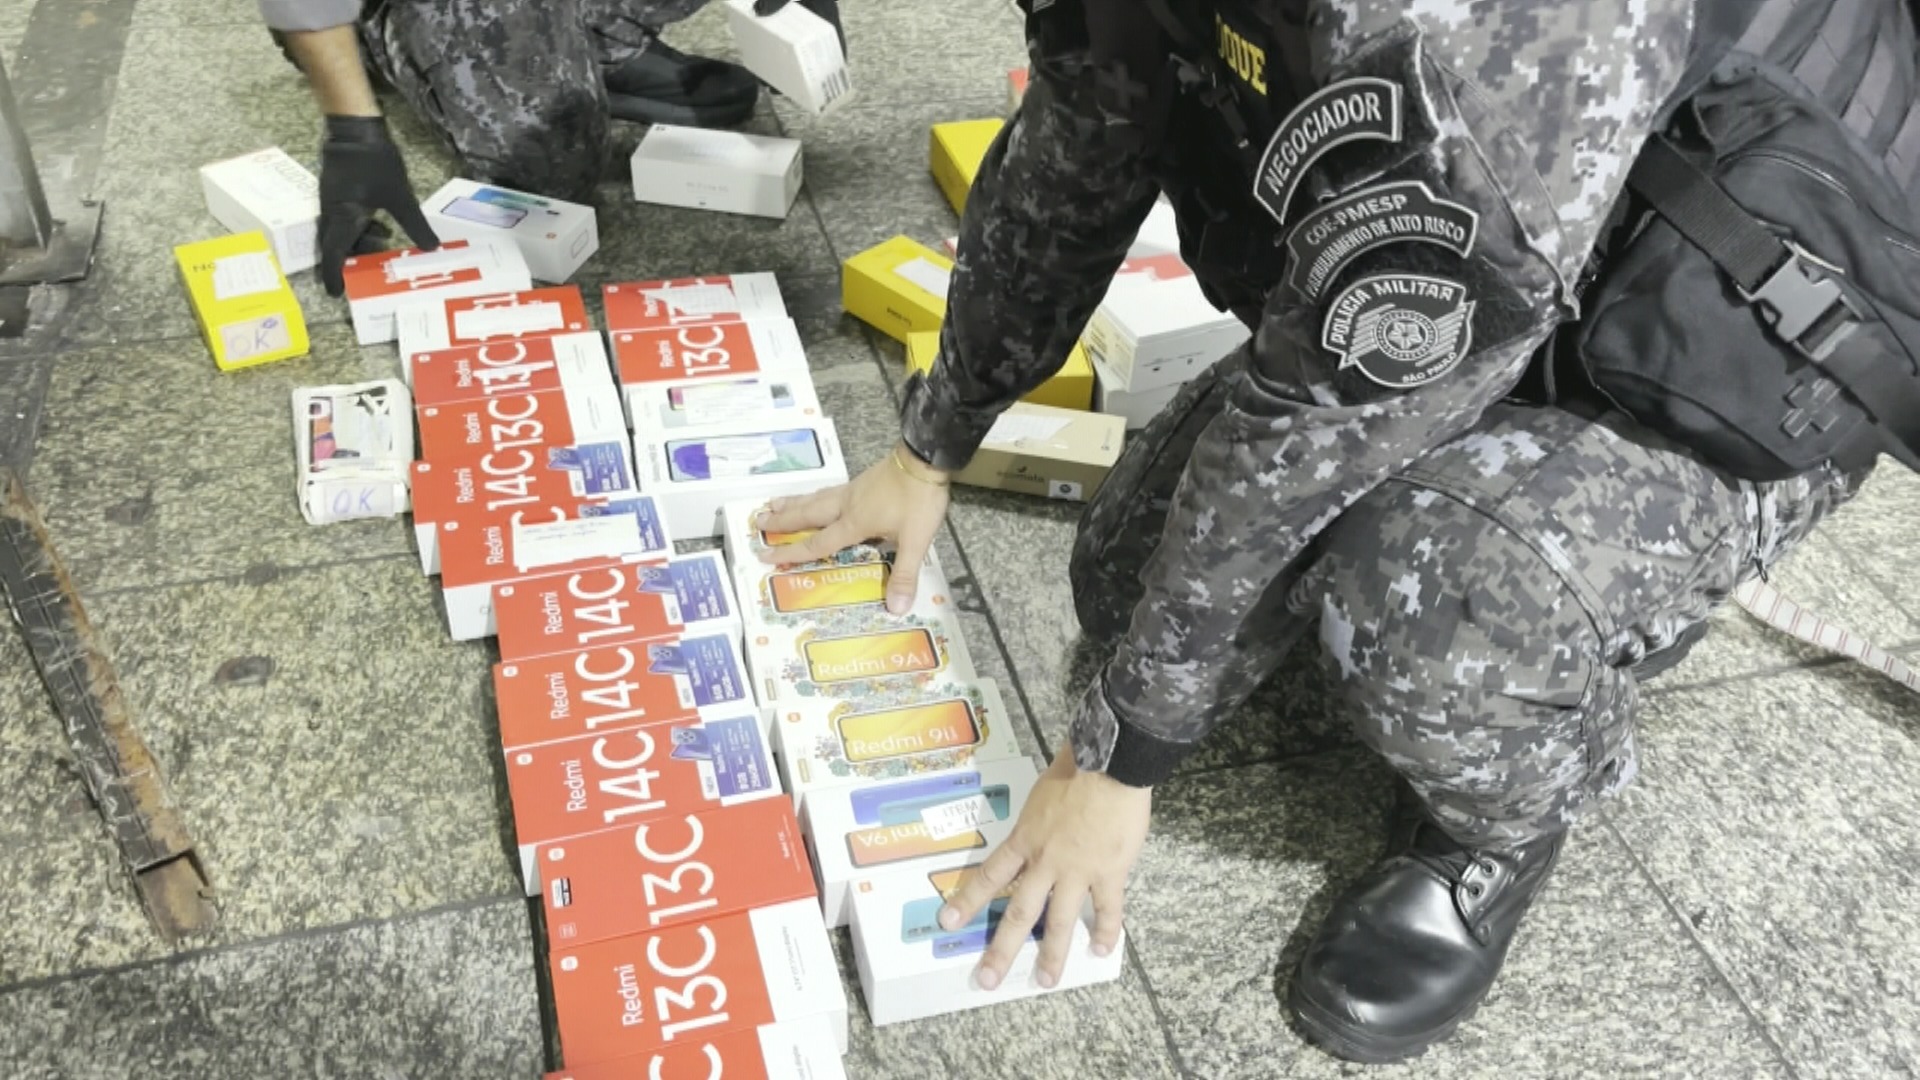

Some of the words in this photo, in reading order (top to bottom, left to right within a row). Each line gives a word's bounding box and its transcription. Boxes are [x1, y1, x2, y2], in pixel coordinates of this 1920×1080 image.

[1264, 90, 1382, 195] NEGOCIADOR
[1305, 193, 1408, 246] COE-PMESP
[1368, 218, 1392, 238] DE
[1389, 214, 1422, 234] ALTO
[1424, 215, 1465, 242] RISCO
[1372, 280, 1454, 301] MILITAR
[657, 339, 675, 368] Redmi
[677, 325, 731, 376] 13C
[462, 411, 483, 444] Redmi
[488, 393, 544, 452] 13C
[332, 486, 375, 515] OK
[453, 467, 474, 504] Redmi
[480, 449, 541, 511] 14C
[483, 525, 505, 566] Redmi
[539, 589, 564, 636] Redmi
[567, 567, 636, 644] 14C
[543, 670, 570, 720] Redmi
[574, 646, 646, 730] 14C
[817, 653, 888, 677] Redmi
[850, 733, 924, 756] Redmi
[560, 757, 588, 813] Redmi
[592, 729, 667, 824] 14C
[942, 800, 979, 817] ITEM
[634, 813, 719, 926] 13C
[613, 963, 644, 1028] Redmi
[646, 924, 730, 1041] 13C
